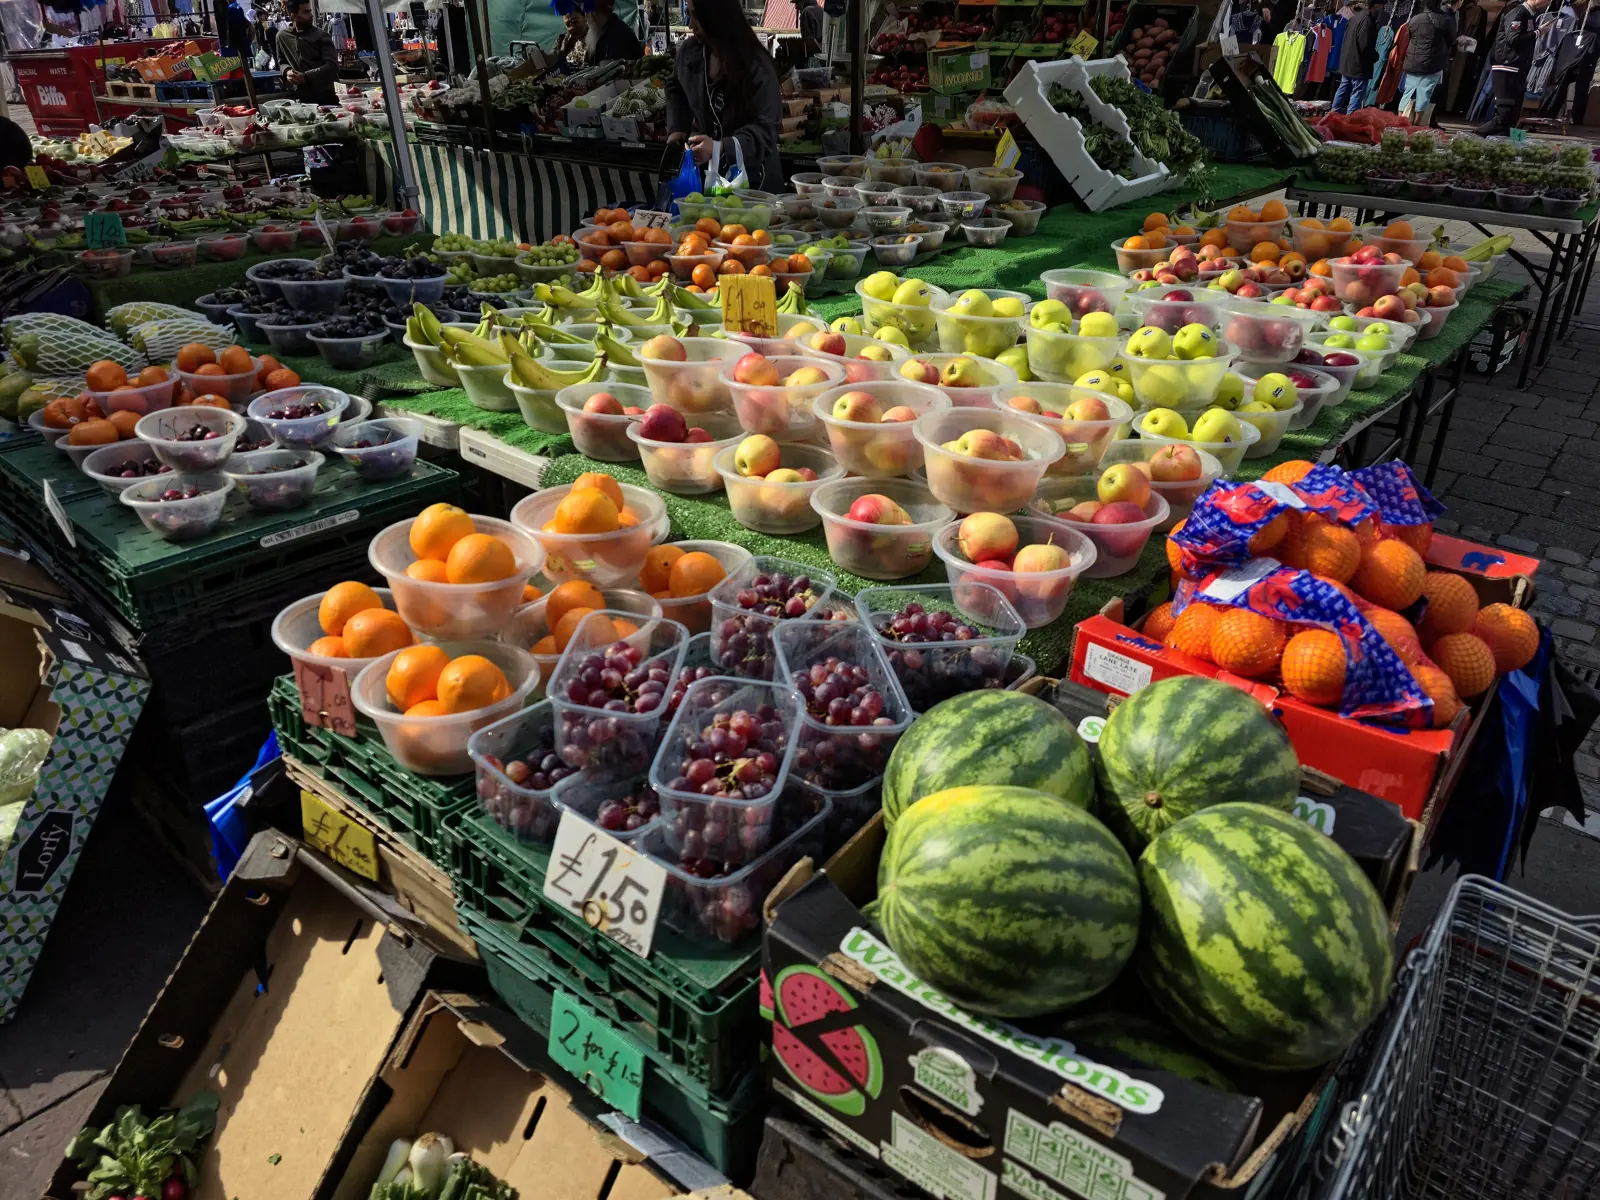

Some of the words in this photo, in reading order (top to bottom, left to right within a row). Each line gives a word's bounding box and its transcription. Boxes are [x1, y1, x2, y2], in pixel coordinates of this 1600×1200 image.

[17, 68, 38, 76] GENERAL
[49, 67, 68, 75] WASTE
[37, 85, 67, 106] Biffa
[1100, 655, 1116, 666] LANE
[1120, 663, 1138, 673] LATE
[22, 824, 70, 880] Lorfy
[551, 832, 649, 925] £1.50
[558, 1010, 580, 1056] 2
[582, 1031, 604, 1061] for
